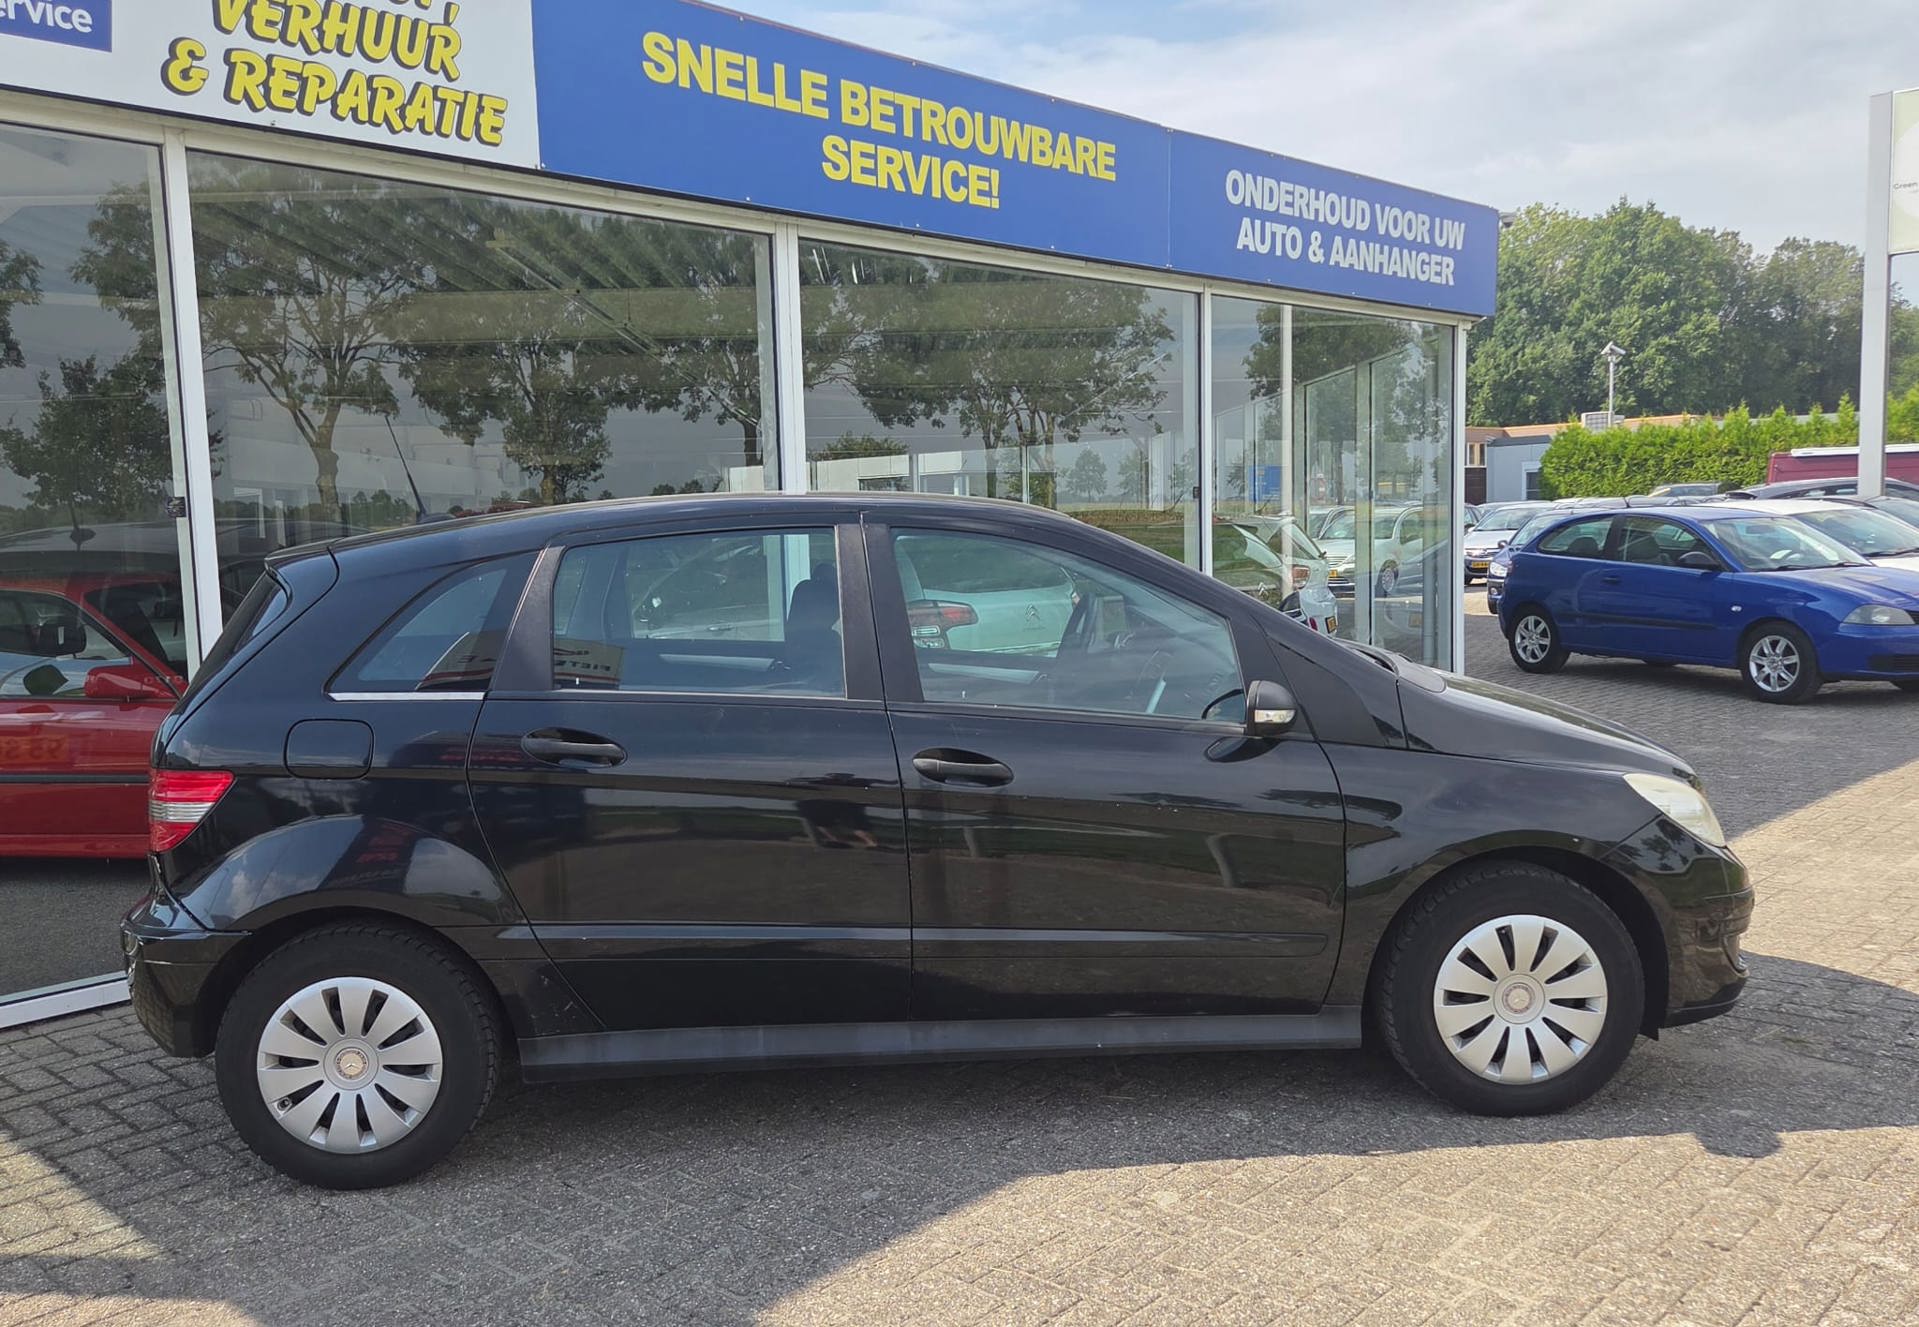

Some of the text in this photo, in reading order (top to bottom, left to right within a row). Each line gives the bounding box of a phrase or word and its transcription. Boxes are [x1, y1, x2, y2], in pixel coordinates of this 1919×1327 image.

[211, 0, 461, 82] VERHUUR
[161, 37, 508, 146] & REPARATIE
[642, 31, 1116, 181] SNELLE BETROUWBARE
[822, 135, 1000, 209] SERVICE!
[1225, 169, 1466, 250] ONDERHOUD VOOR UW
[1236, 217, 1455, 286] AUTO & AANHANGER
